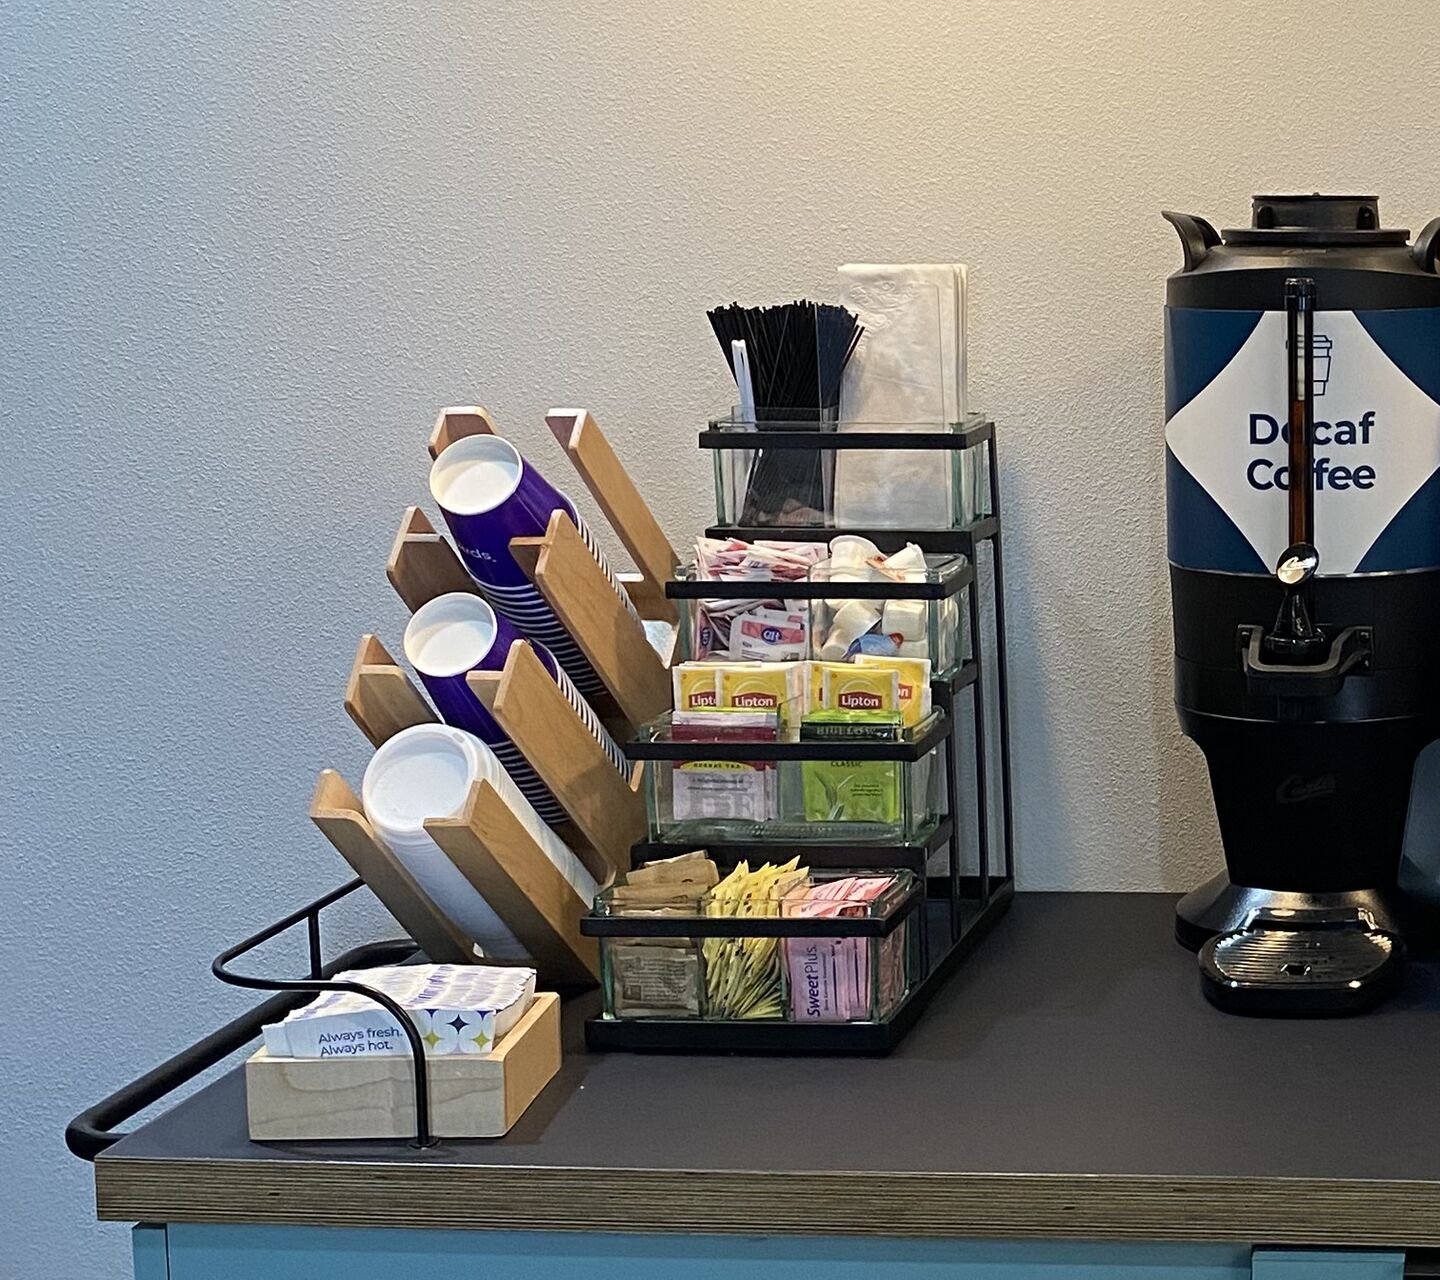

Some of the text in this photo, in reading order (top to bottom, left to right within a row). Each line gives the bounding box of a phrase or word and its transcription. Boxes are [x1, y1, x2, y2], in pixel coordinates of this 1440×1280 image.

[1246, 457, 1376, 491] Cofee
[691, 695, 716, 707] Lipt
[735, 696, 774, 707] Lipton
[841, 694, 880, 708] Lipton
[319, 1026, 403, 1044] Always fresh.
[320, 1040, 393, 1057] Always hot.
